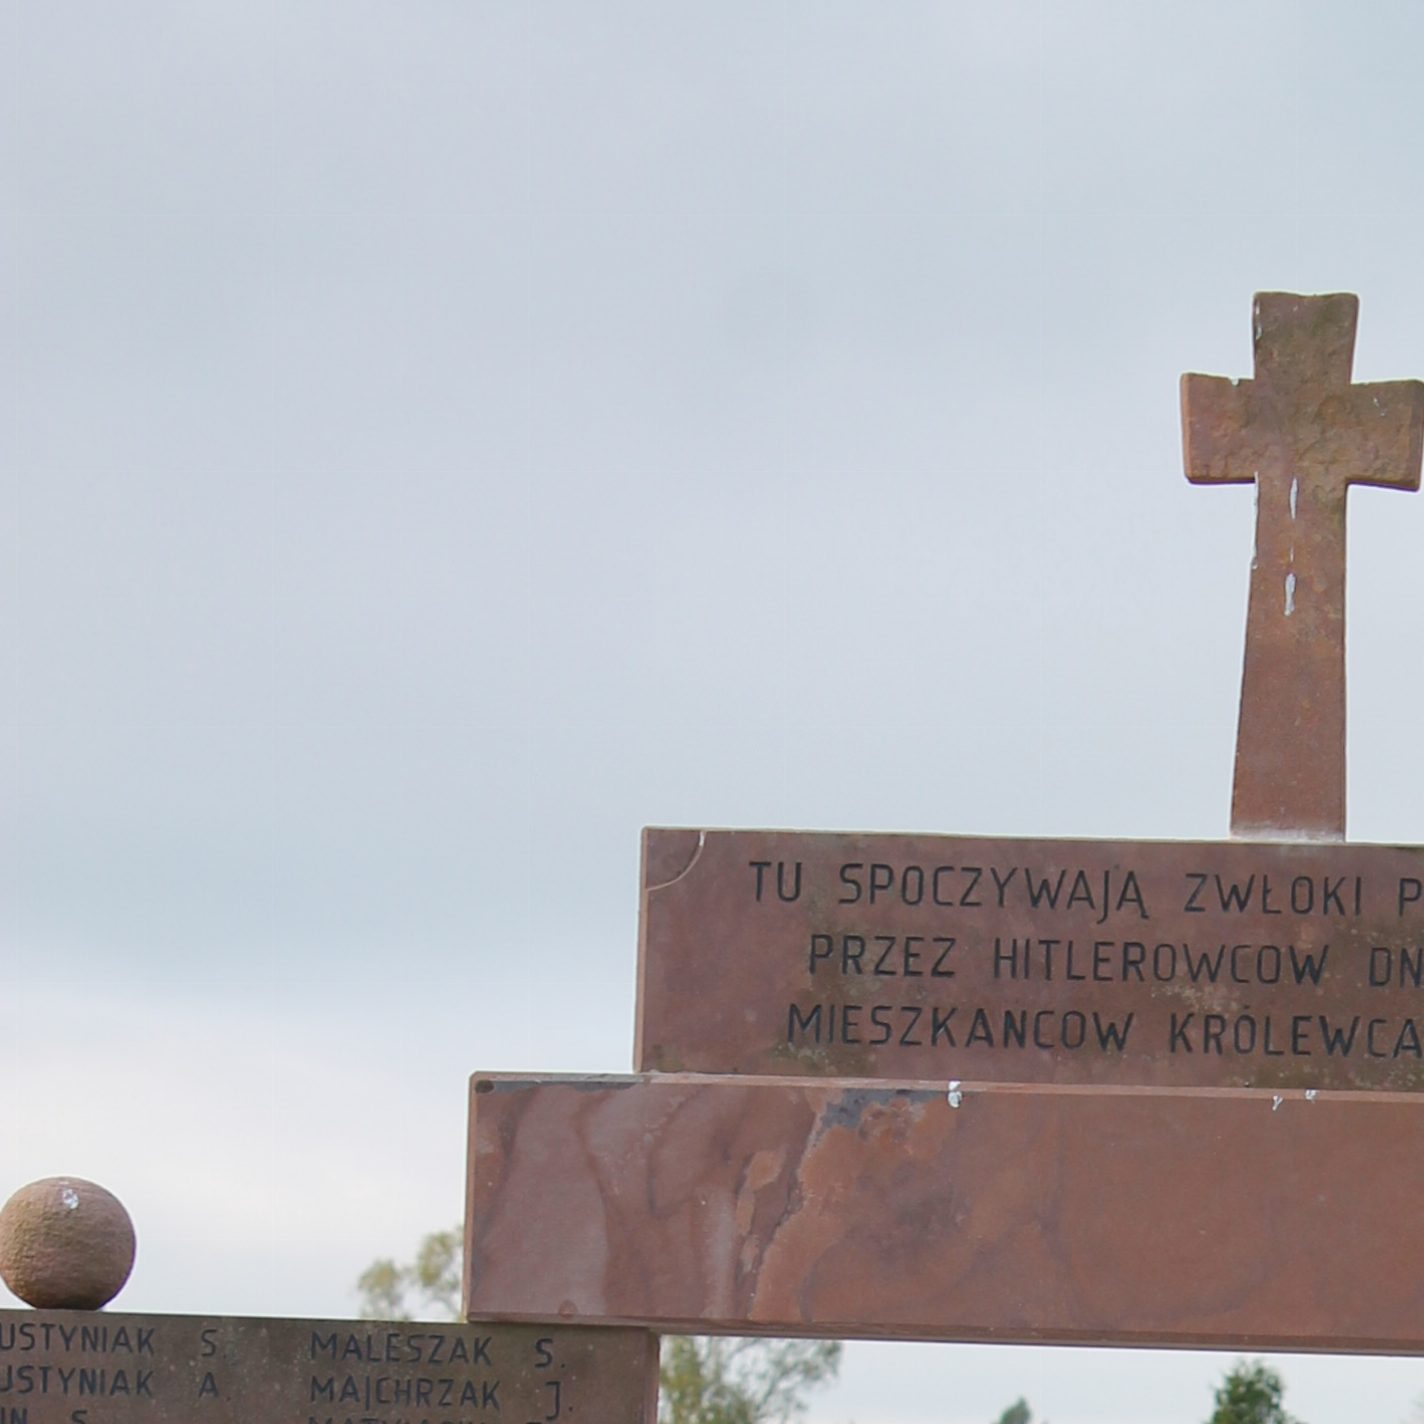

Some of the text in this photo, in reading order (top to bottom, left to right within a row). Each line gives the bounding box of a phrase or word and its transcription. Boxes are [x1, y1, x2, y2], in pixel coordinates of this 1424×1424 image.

[748, 860, 803, 902] TU
[837, 863, 1150, 925] SPOCZYWAJĄ
[1183, 872, 1363, 917] ZWŁOKI
[808, 933, 958, 978] PRZEZ
[992, 937, 1330, 986] HITLEROWCOW
[786, 1003, 1135, 1052] MIESZKANCOW
[309, 1331, 493, 1366] MALESZAK
[309, 1375, 500, 1412] MAJCHRZAK
